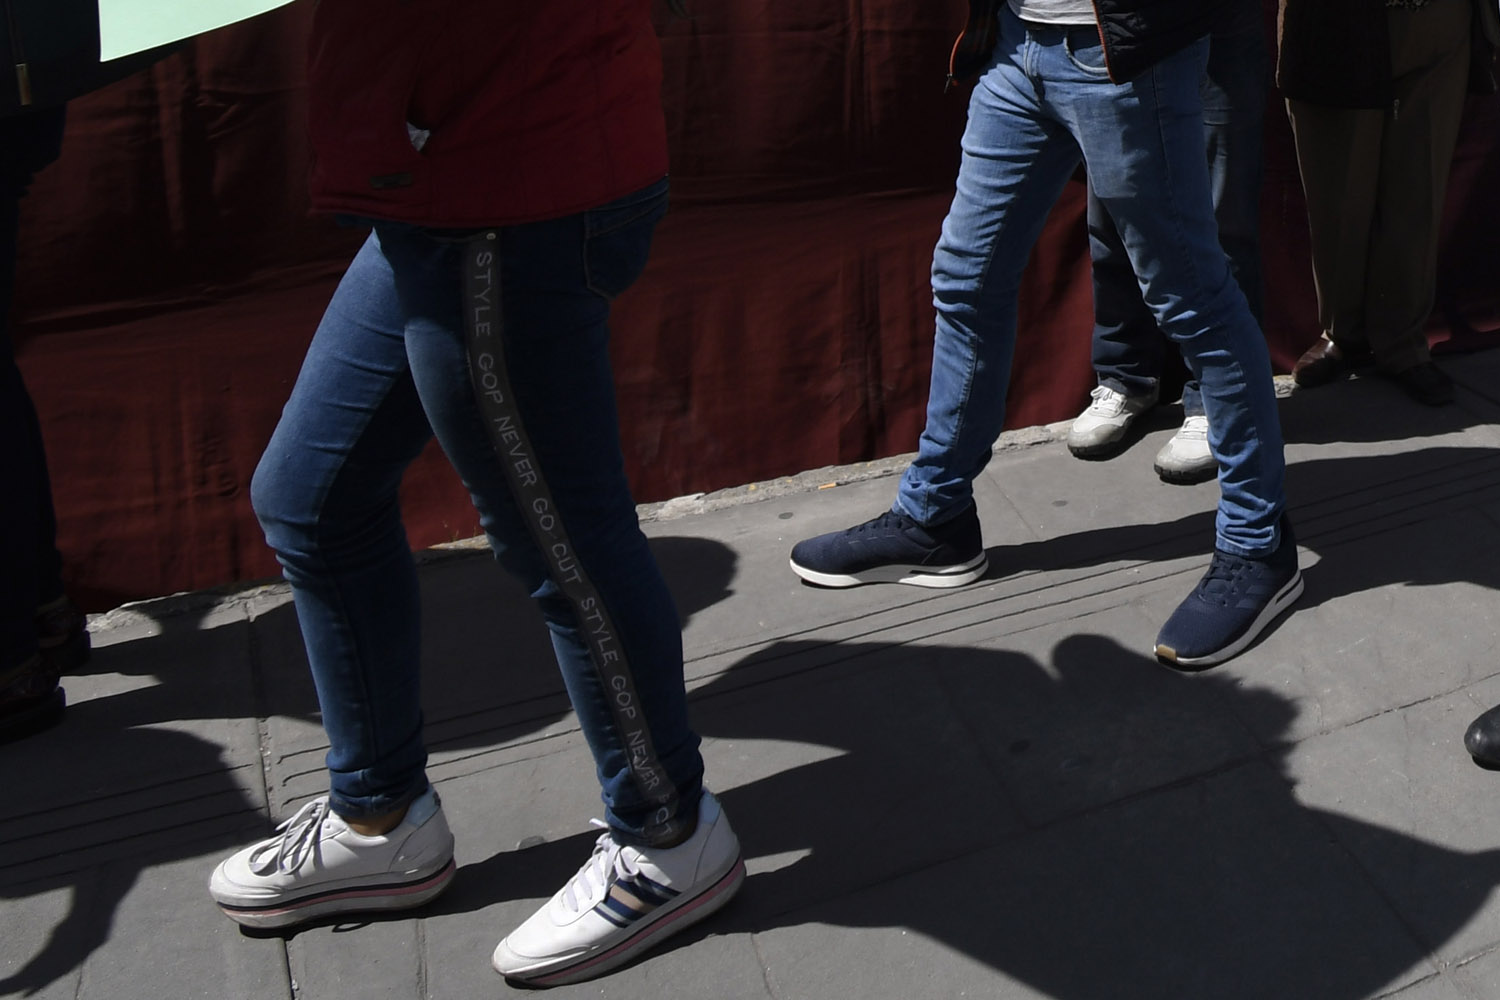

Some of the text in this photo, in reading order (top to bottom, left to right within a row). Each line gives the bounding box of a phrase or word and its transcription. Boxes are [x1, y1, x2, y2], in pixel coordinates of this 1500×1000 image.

[473, 251, 493, 337] STYLE
[478, 352, 504, 404] GOP
[493, 415, 538, 487] NEVER
[581, 597, 619, 667] STYLE
[611, 675, 637, 720] GOP
